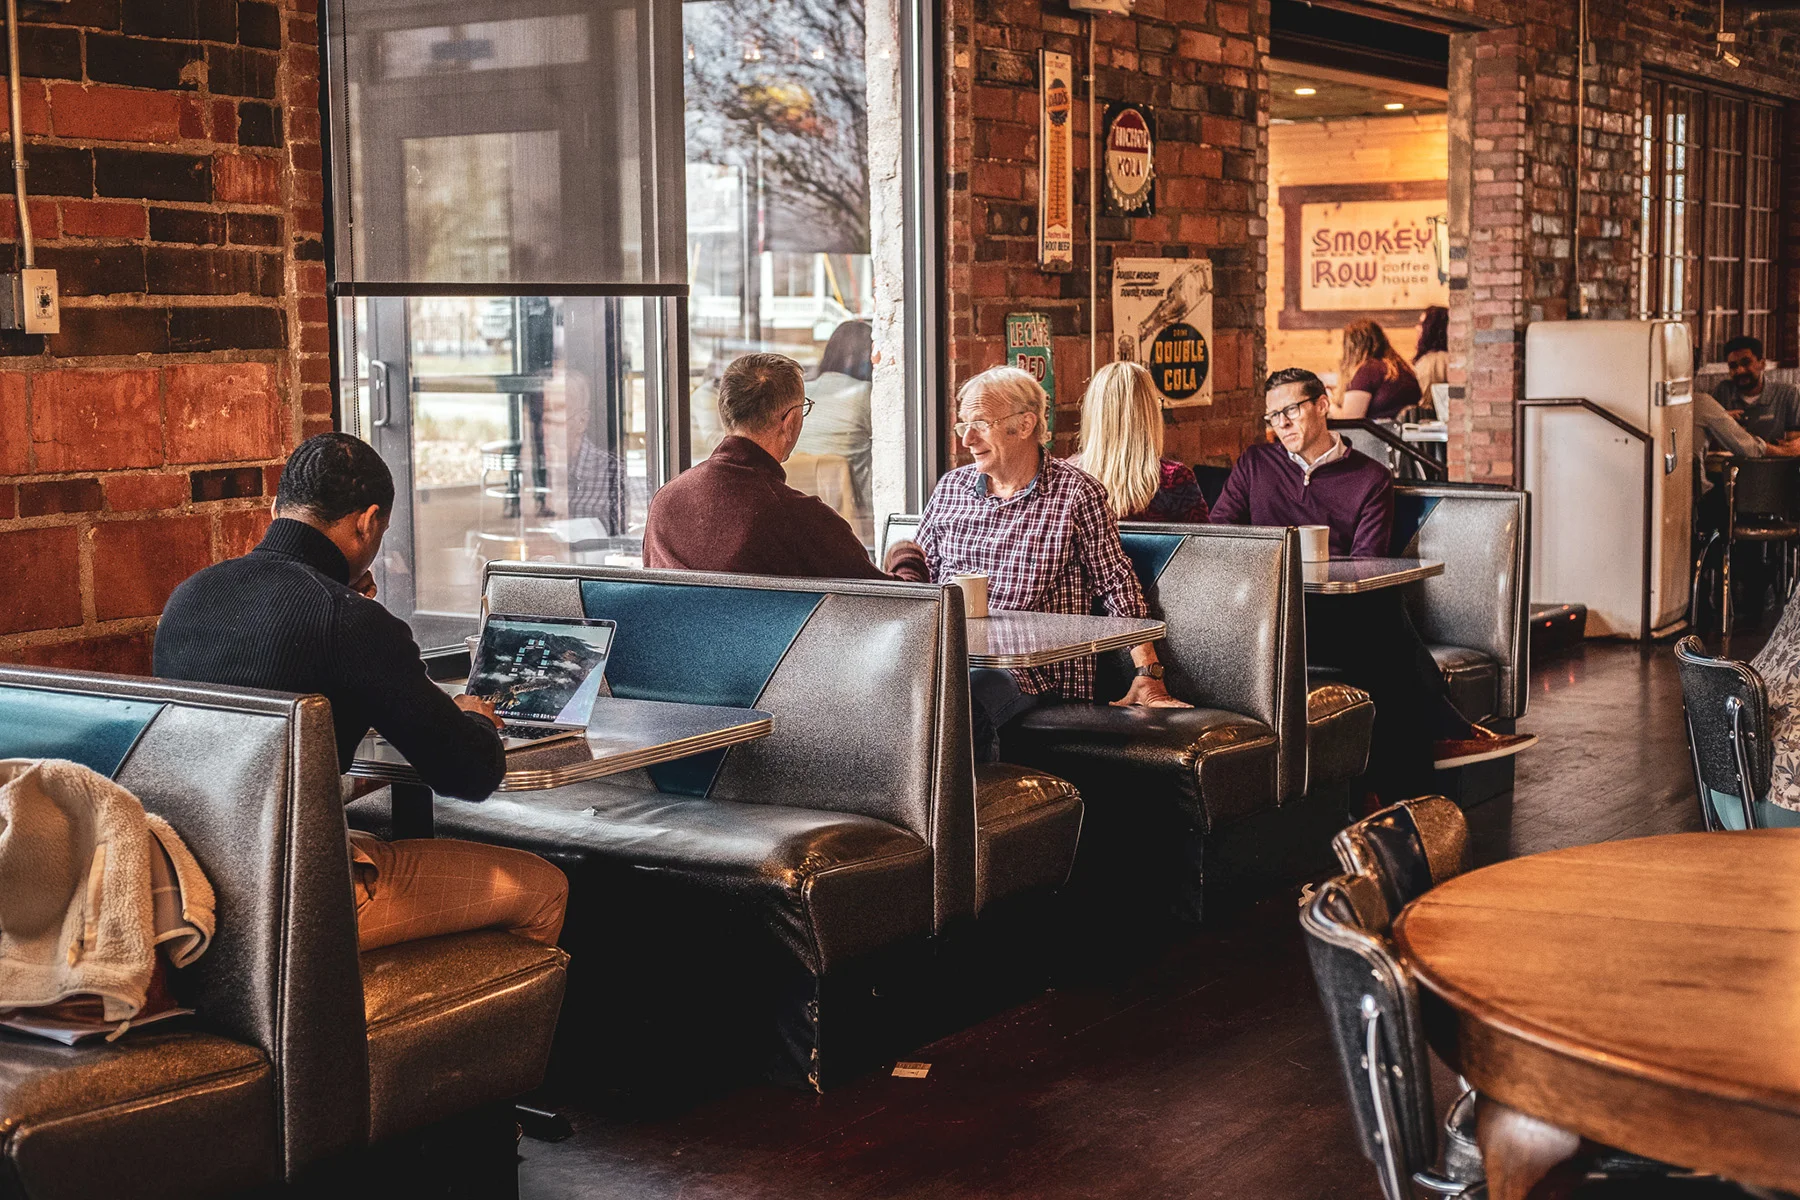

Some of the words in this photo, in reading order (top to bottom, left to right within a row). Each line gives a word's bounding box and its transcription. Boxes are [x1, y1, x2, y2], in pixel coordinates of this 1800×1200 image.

[1115, 126, 1149, 148] NICHOL
[1118, 156, 1143, 177] KOLA
[1045, 241, 1058, 251] ROOT
[1058, 241, 1071, 251] BEER
[1312, 228, 1433, 256] SMOKEY
[1116, 271, 1136, 279] DOUBLE
[1136, 271, 1160, 280] MEASURE
[1312, 260, 1377, 288] ROW
[1382, 261, 1430, 273] coffee
[1382, 275, 1429, 285] house
[1120, 288, 1140, 297] DOUBLE
[1140, 288, 1165, 298] PLEASURE
[1155, 340, 1205, 363] DOUBLE
[1164, 368, 1197, 391] COLA
